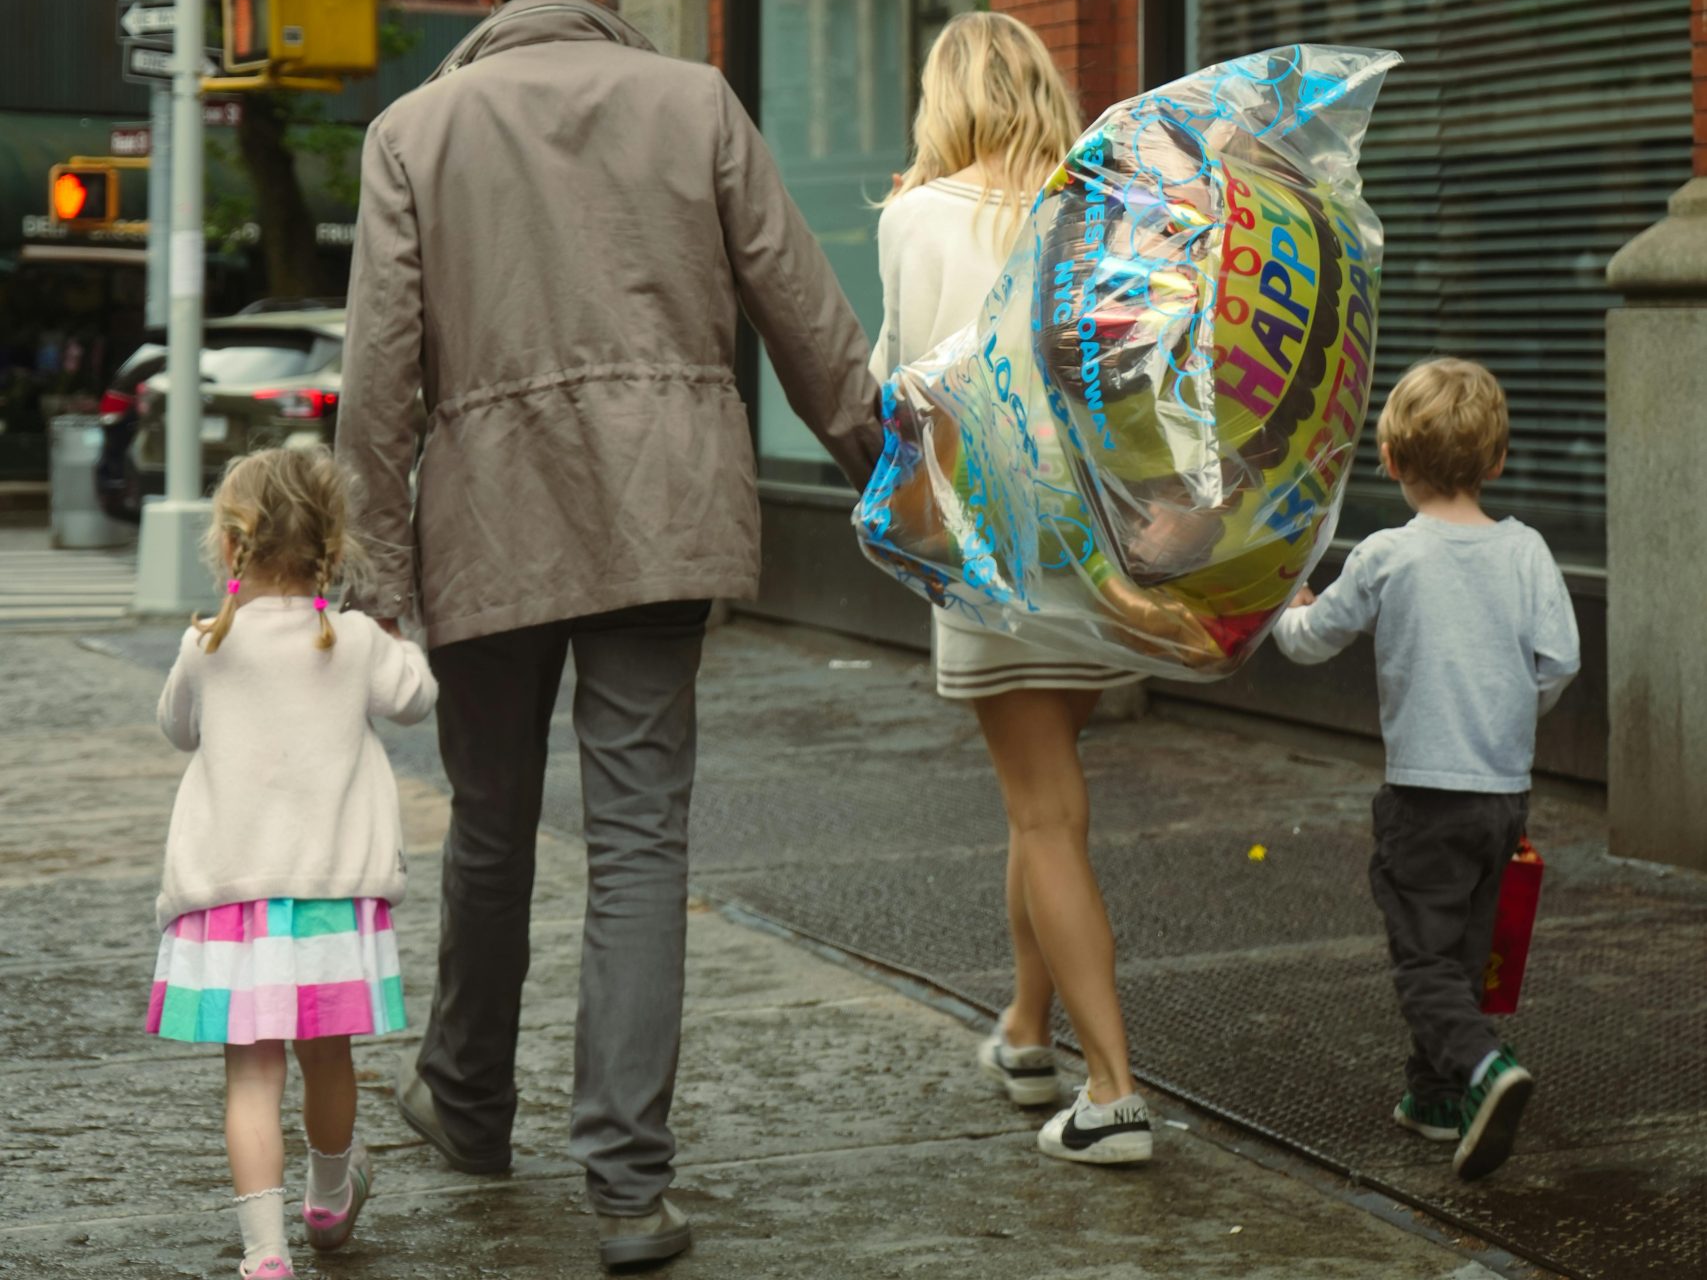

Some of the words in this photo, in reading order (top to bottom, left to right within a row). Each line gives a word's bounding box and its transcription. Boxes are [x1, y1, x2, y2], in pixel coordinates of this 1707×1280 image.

[1084, 174, 1105, 261] WEST
[1053, 259, 1075, 326] NYC
[1214, 186, 1317, 419] HAPPY
